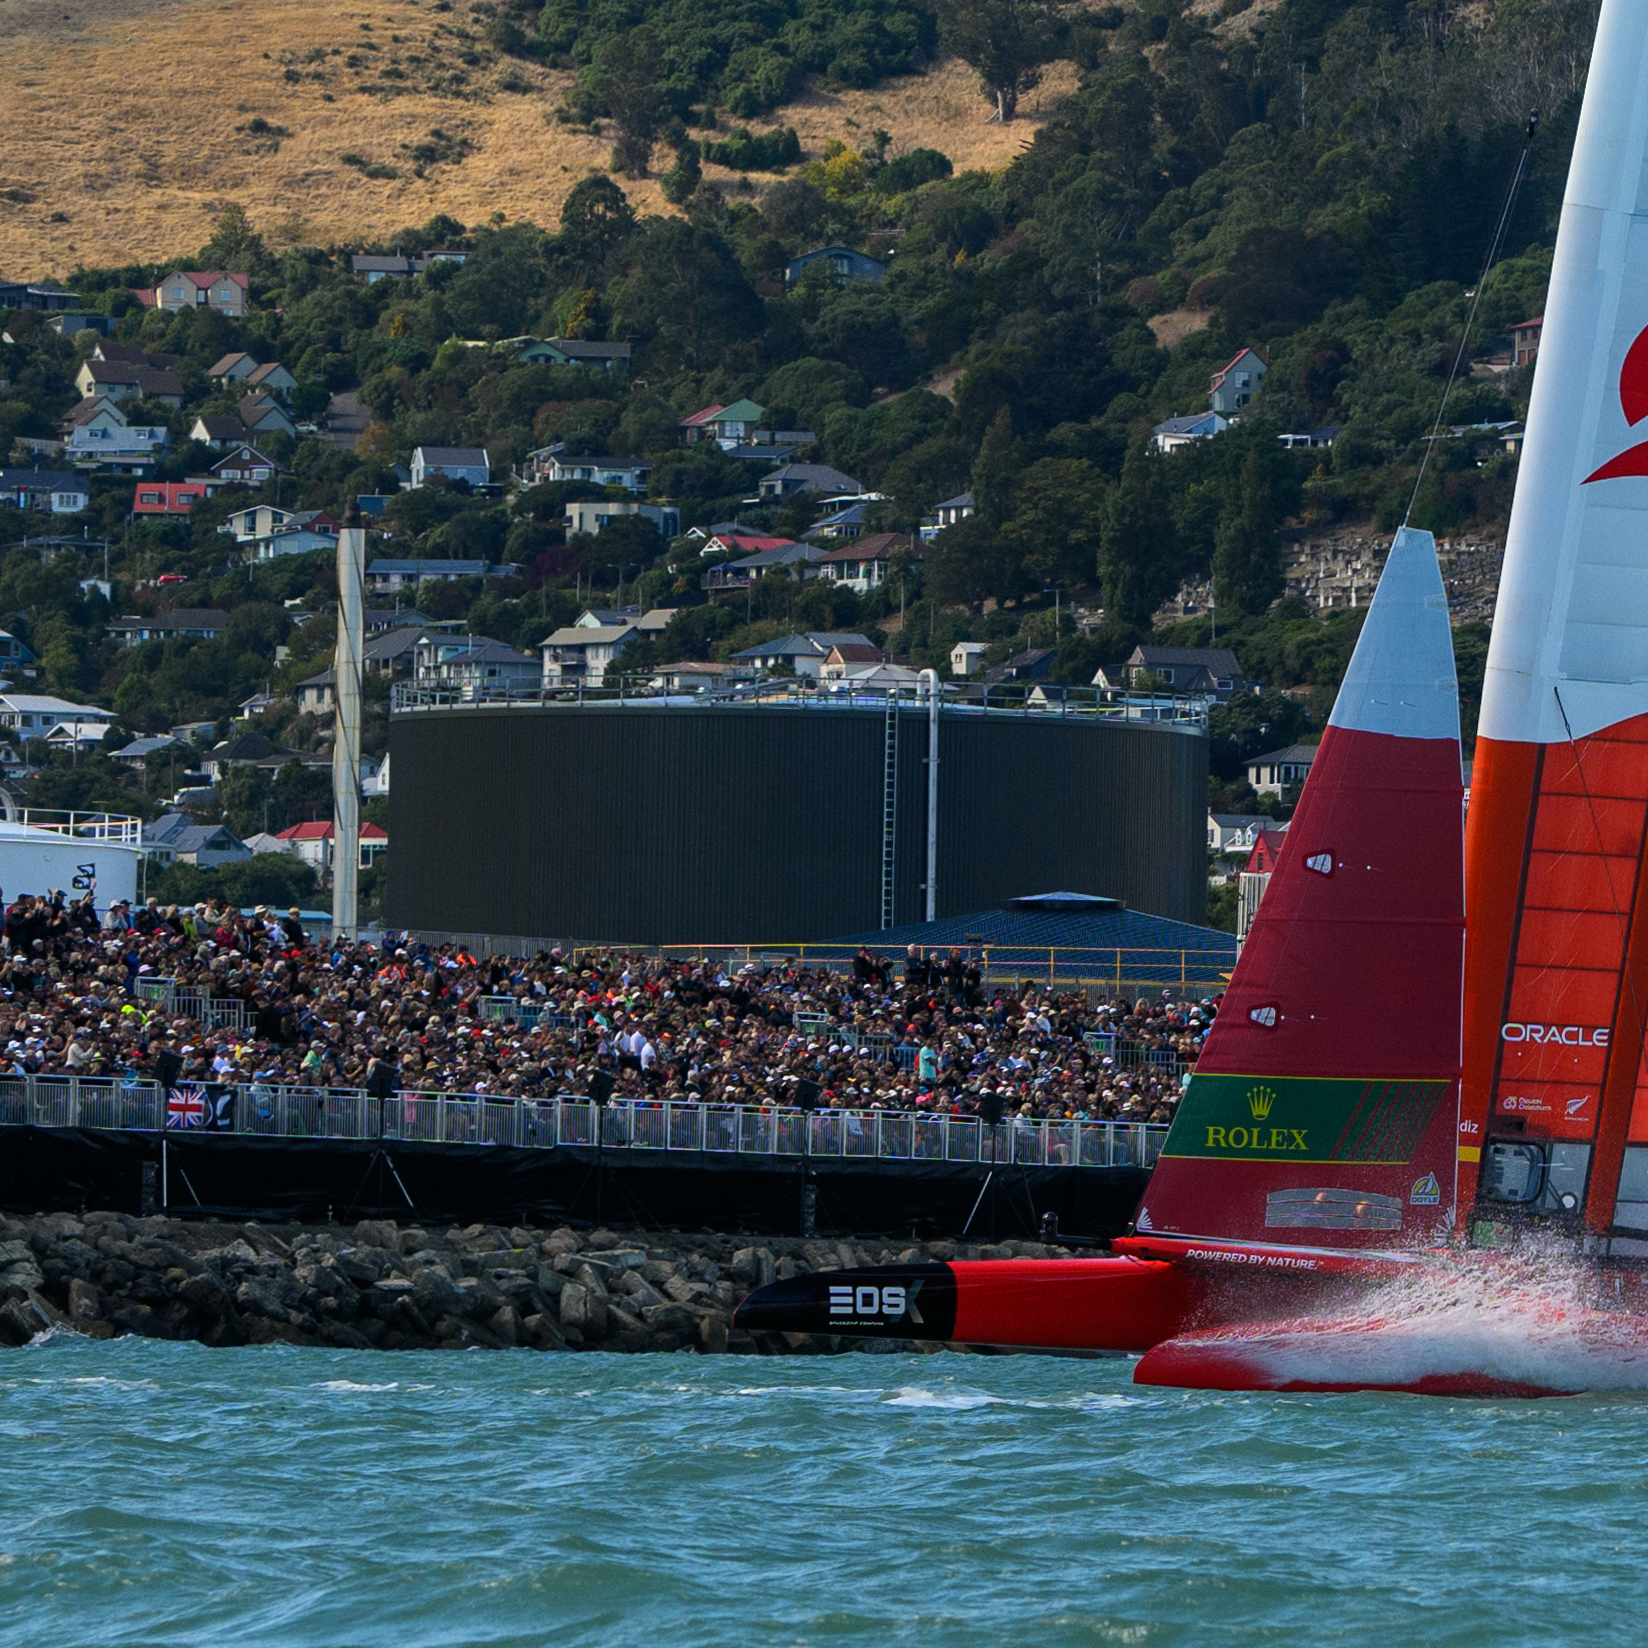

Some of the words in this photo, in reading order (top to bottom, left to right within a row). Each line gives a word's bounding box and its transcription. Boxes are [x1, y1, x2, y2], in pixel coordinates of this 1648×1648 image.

[1501, 1023, 1610, 1047] ORACLE
[1205, 1126, 1309, 1150] ROLEX
[1186, 1249, 1248, 1263] POWERED
[1248, 1255, 1266, 1265] BY
